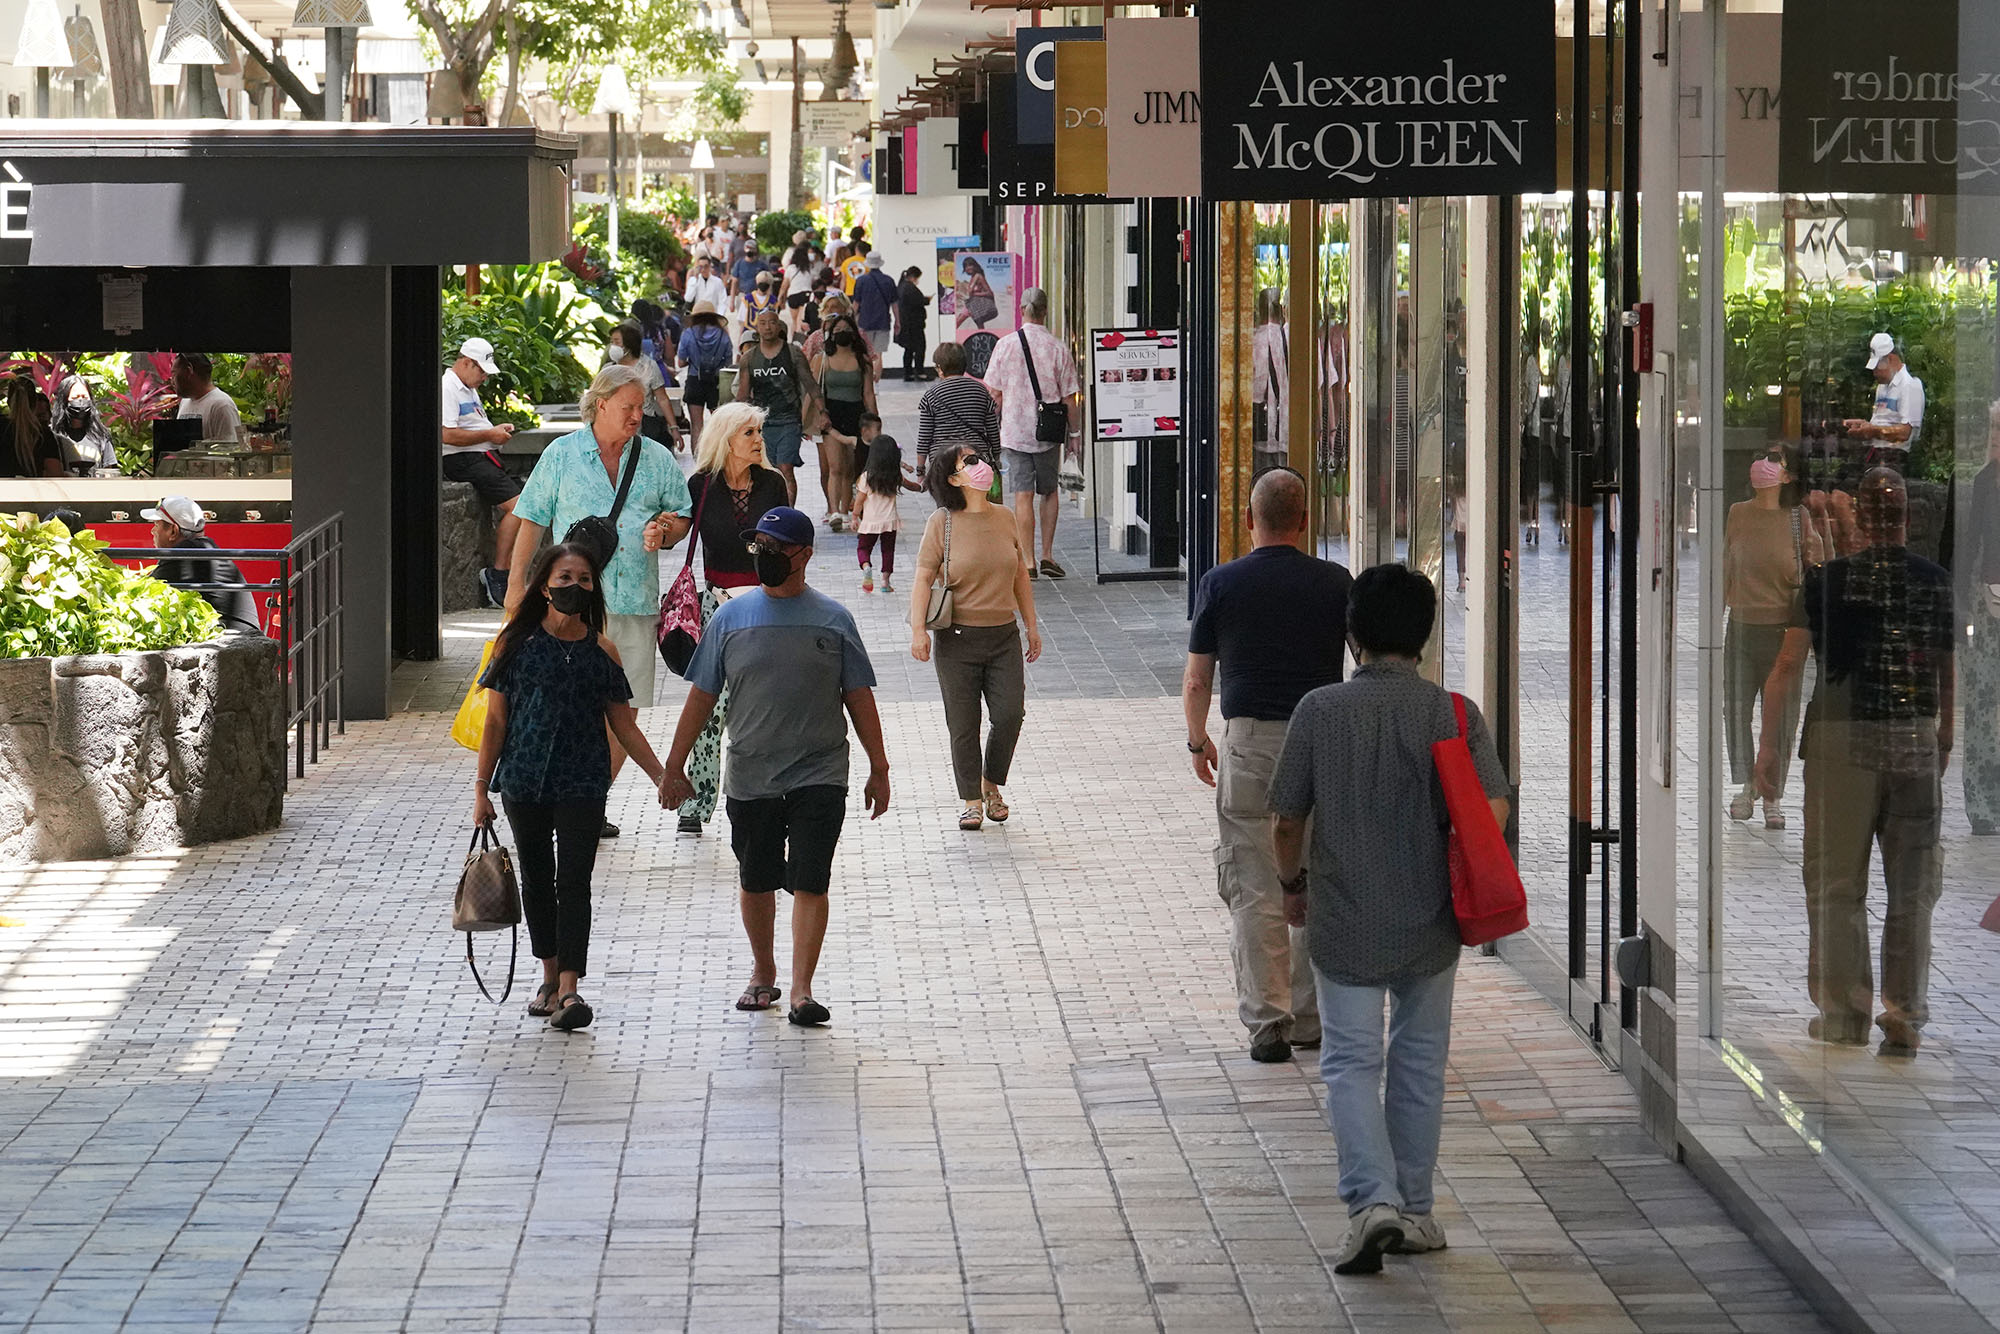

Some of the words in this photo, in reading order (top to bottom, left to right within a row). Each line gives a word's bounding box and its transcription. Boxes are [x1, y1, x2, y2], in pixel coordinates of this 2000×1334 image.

[1249, 58, 1507, 107] Alexander
[1232, 119, 1528, 184] McQUEEN
[987, 256, 1009, 265] FREE
[1119, 351, 1157, 360] SERVICES
[753, 366, 787, 377] RVCA
